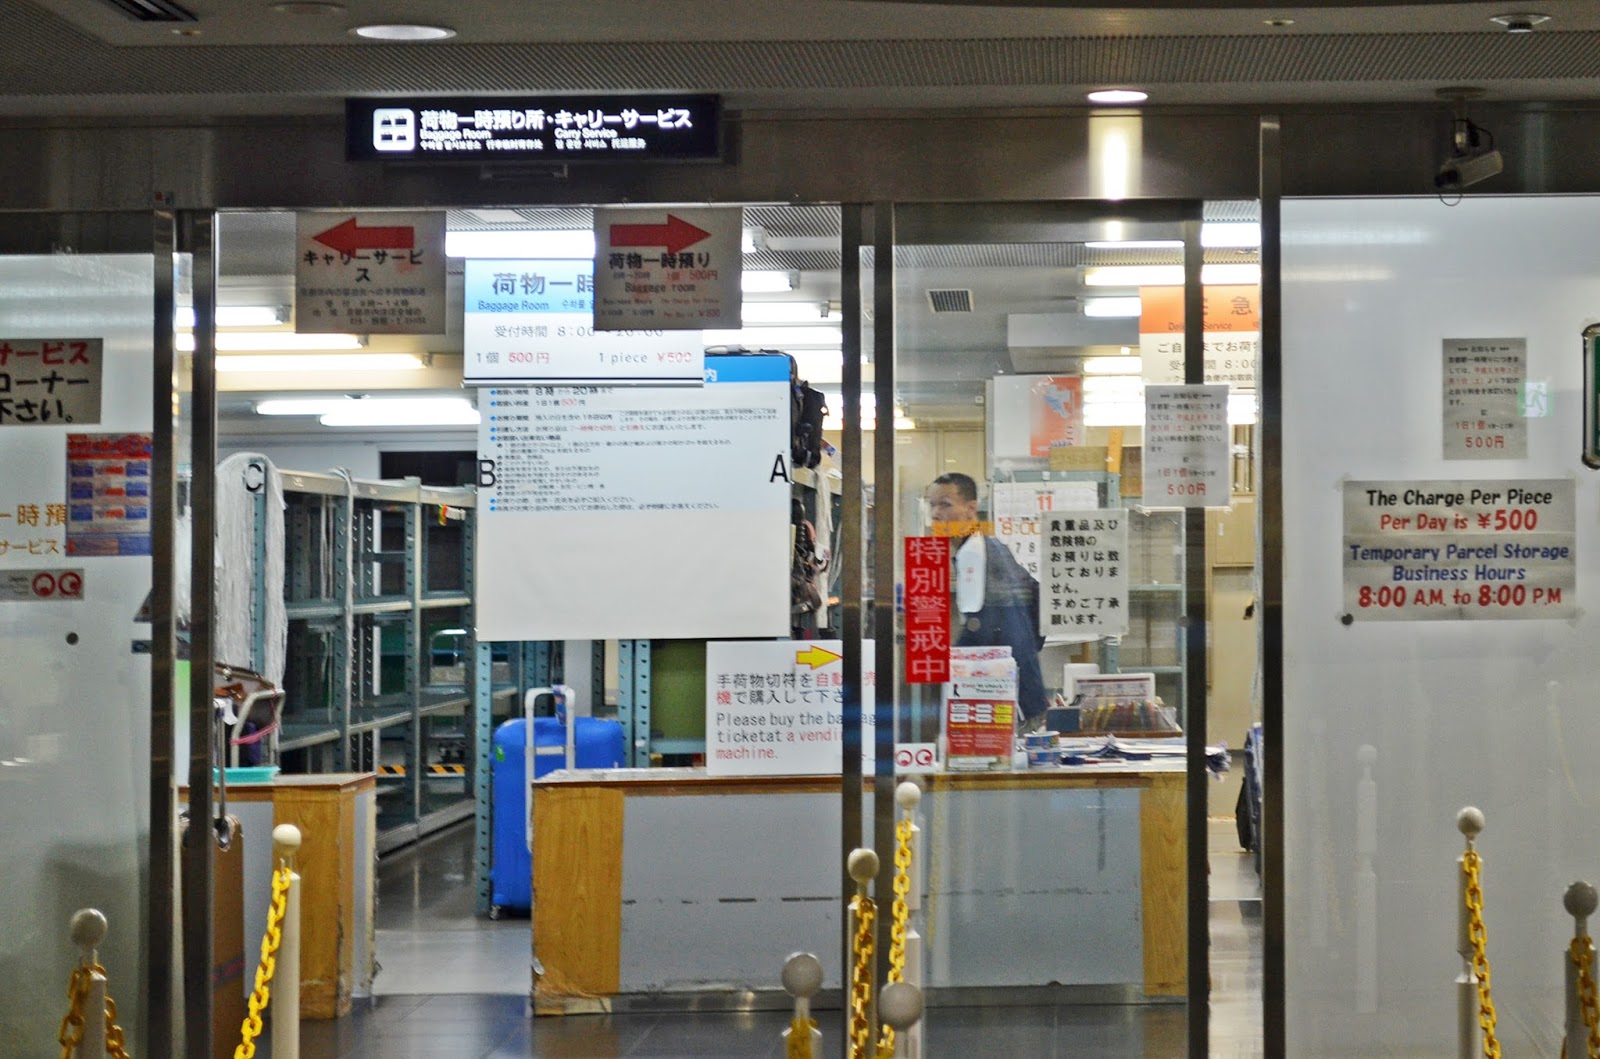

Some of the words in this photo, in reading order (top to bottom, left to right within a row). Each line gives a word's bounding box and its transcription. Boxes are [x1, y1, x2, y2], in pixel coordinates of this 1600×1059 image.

[420, 109, 693, 130] 荷物一時預り所・キャリーサービス
[419, 128, 461, 140] Baggage
[463, 128, 492, 140] Room
[554, 127, 581, 140] Carry
[582, 127, 618, 139] Service
[609, 252, 710, 269] 荷物一時預り
[355, 267, 370, 282] ス
[478, 300, 521, 312] Baggage
[521, 300, 550, 311] Room
[495, 325, 548, 338] 受付時間
[611, 352, 648, 364] piece
[1465, 436, 1504, 448] 500円
[478, 458, 496, 487] B
[769, 453, 788, 483] A
[246, 463, 263, 492] C
[1038, 496, 1053, 510] 11
[1366, 490, 1397, 506] The
[1403, 490, 1464, 507] Charge
[1470, 490, 1501, 504] Per
[1507, 488, 1552, 504] Piece
[1050, 519, 1119, 532] 貴重品及び
[1380, 514, 1410, 530] Per
[1417, 513, 1447, 531] Day
[1454, 513, 1468, 529] is
[1050, 535, 1097, 547] 危険物の
[1050, 550, 1119, 563] お預りは致
[1350, 545, 1439, 562] Temporary
[1446, 545, 1498, 559] Parcel
[1504, 544, 1569, 561] Storage
[1051, 566, 1119, 579] しておりま
[1392, 566, 1468, 581] Business
[1475, 566, 1526, 581] Hours
[1051, 582, 1080, 595] せん。
[1358, 586, 1406, 607] 8:00
[1453, 590, 1471, 604] to
[1477, 585, 1526, 606] 8:00
[910, 539, 947, 682] 特別警戒中
[1051, 597, 1120, 611] 予めご了承
[1050, 613, 1105, 627] 願います。
[716, 671, 875, 689] 手荷物切符を自動売
[716, 690, 842, 705] 機で購入して下さ
[716, 712, 766, 726] Please
[770, 711, 794, 729] buy
[800, 711, 823, 725] the
[717, 730, 782, 744] ticketat
[787, 733, 795, 743] a
[716, 747, 779, 760] machine.
